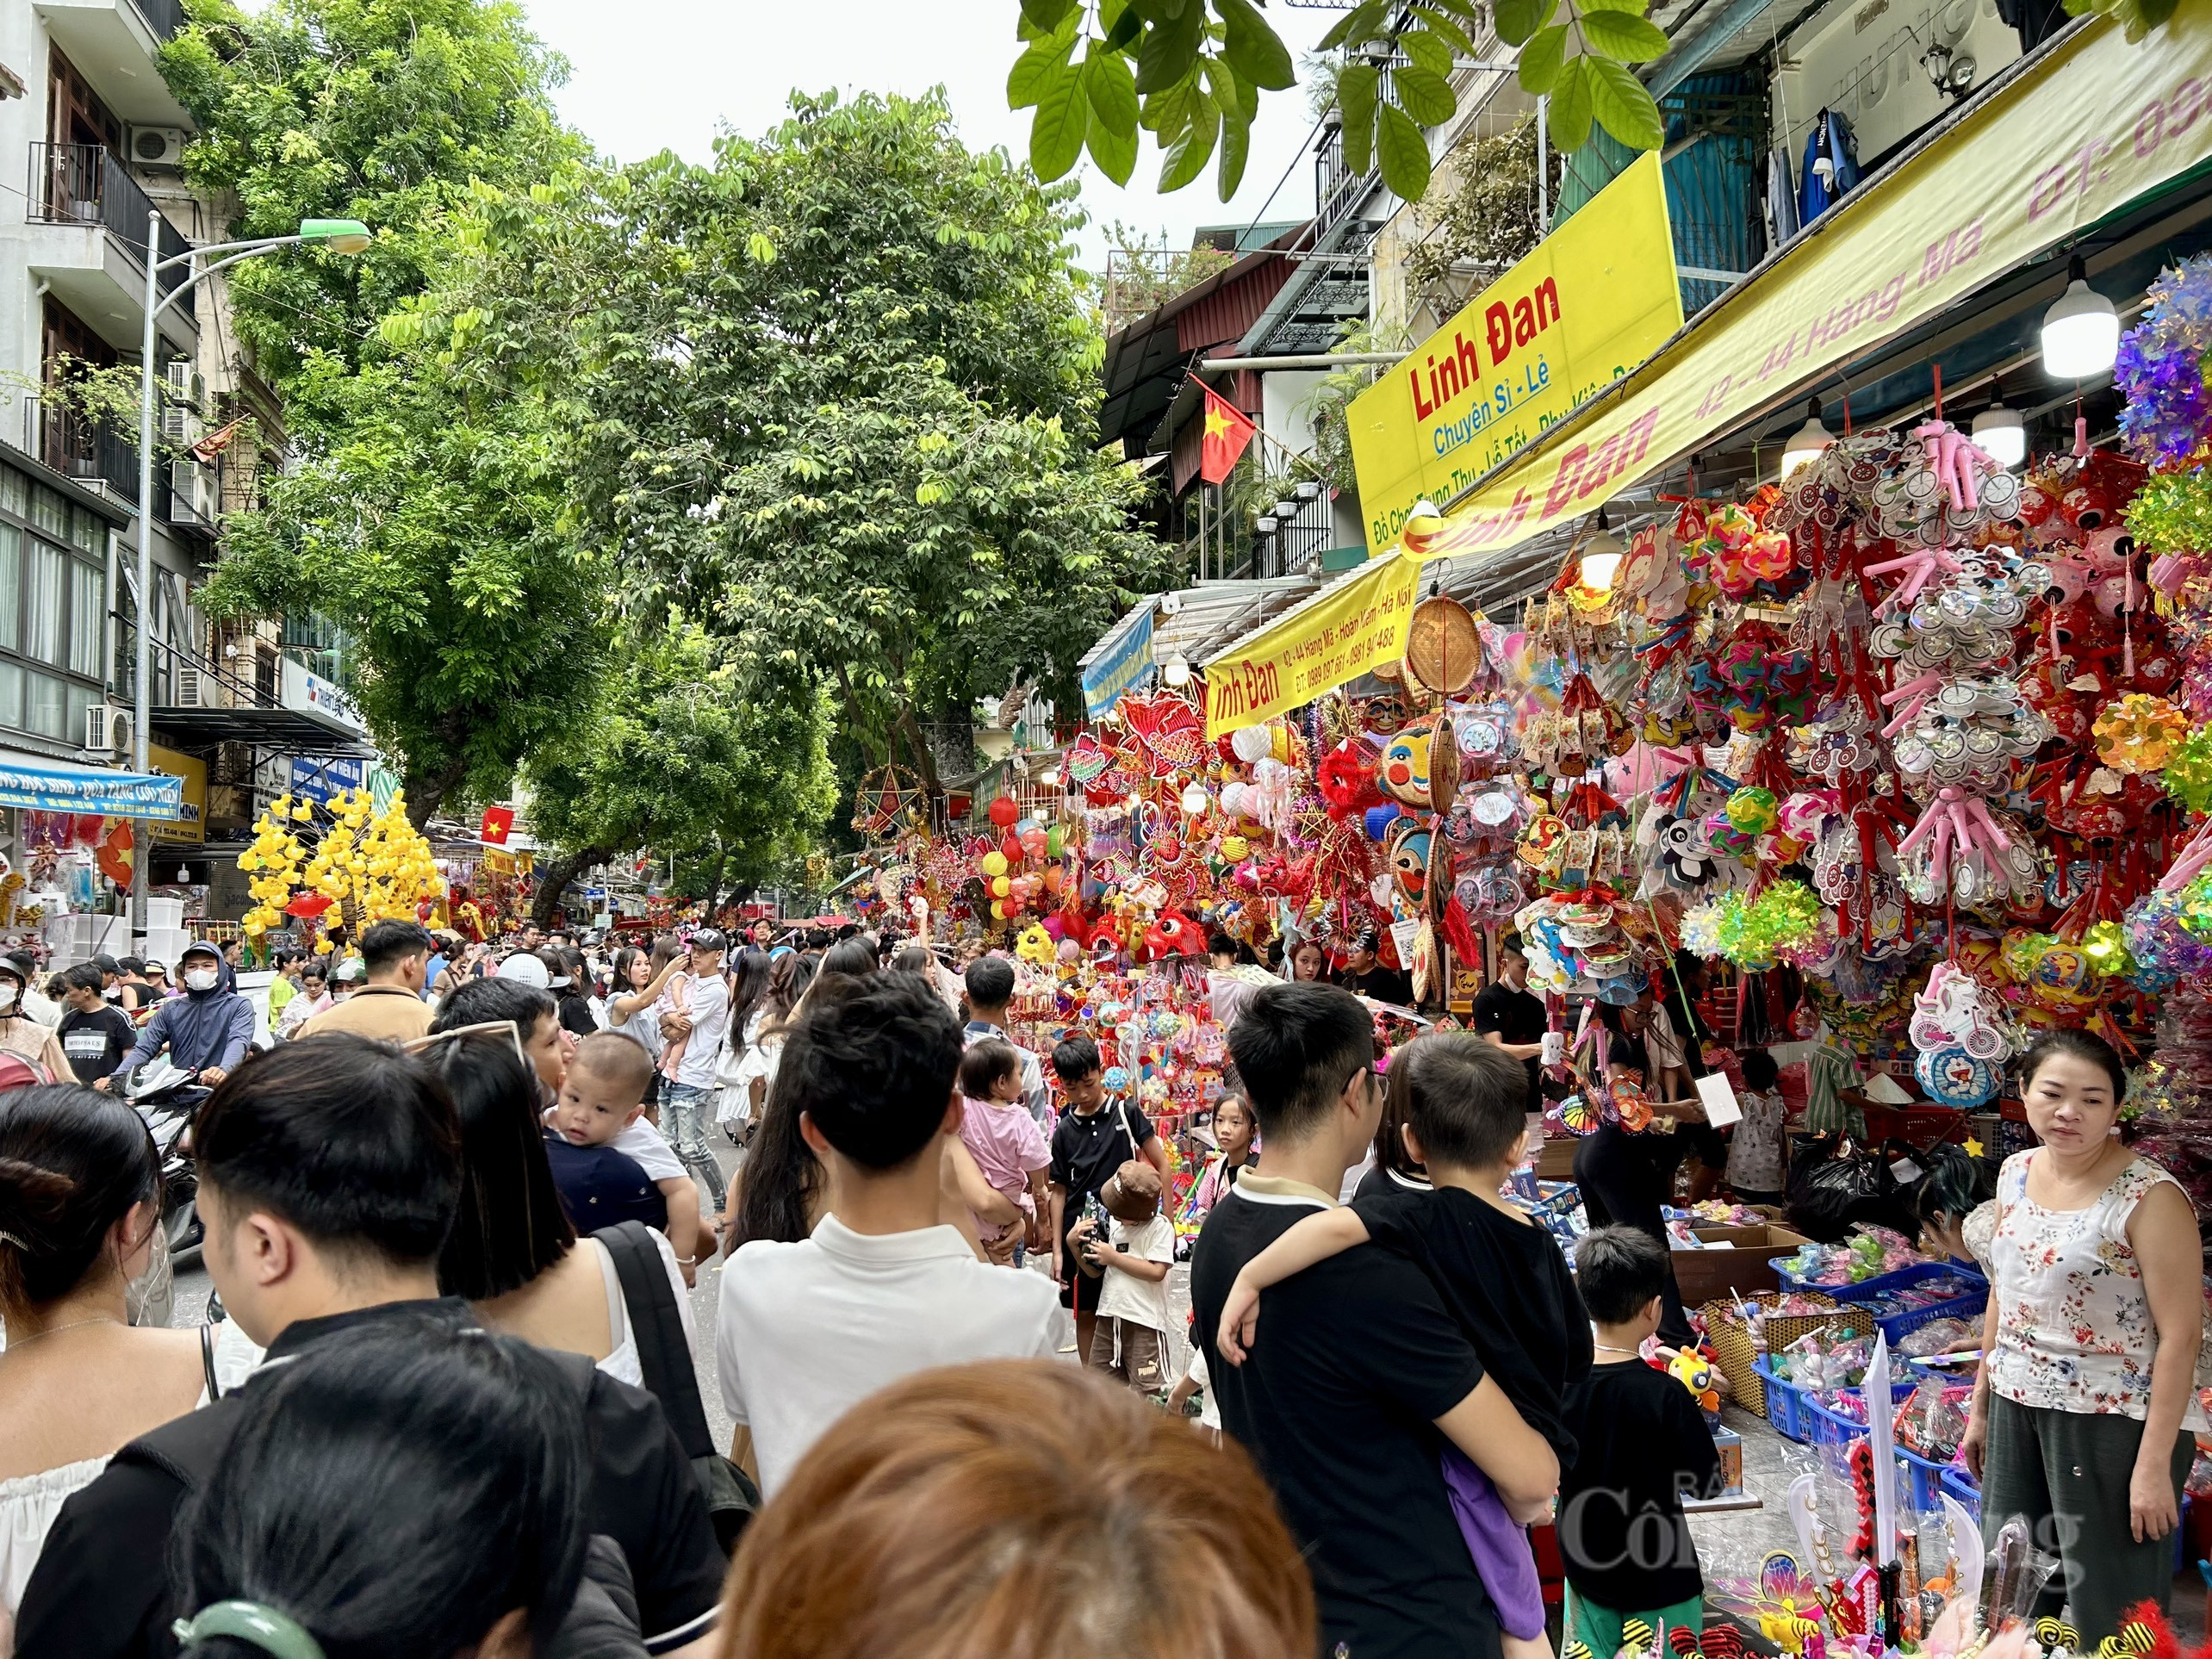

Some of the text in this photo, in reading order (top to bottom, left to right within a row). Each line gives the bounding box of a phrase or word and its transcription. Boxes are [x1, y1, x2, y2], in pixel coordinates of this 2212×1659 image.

[2134, 78, 2212, 158] 09
[1410, 276, 1561, 423] Linh Đan
[1538, 405, 1661, 524] Đan
[1693, 375, 1733, 421] 42
[1757, 331, 1799, 382] 44
[1803, 270, 1908, 357] Hàng
[1917, 212, 1986, 289] Mã
[1433, 401, 1492, 455] Chuyên
[1494, 378, 1513, 413] Sỉ
[1525, 353, 1550, 394] Lẻ
[1373, 511, 1389, 546] Đồ
[1283, 649, 1293, 668] 42
[1295, 644, 1305, 662] 44
[1304, 637, 1323, 657] Hàng
[1322, 626, 1334, 649] Mã
[1339, 616, 1359, 642] Hoàn
[1395, 582, 1412, 612] Nội
[1307, 664, 1322, 688] 0989
[1322, 656, 1335, 681] 097
[1334, 651, 1345, 675] 661
[1350, 640, 1366, 668] 0981
[1376, 625, 1395, 649] 488
[1215, 668, 1245, 722] inh
[1241, 659, 1280, 711] Đan
[14, 773, 46, 797] HỌC
[43, 777, 76, 795] SINH
[81, 778, 105, 800] QUÀ
[106, 779, 135, 804] TẶNG
